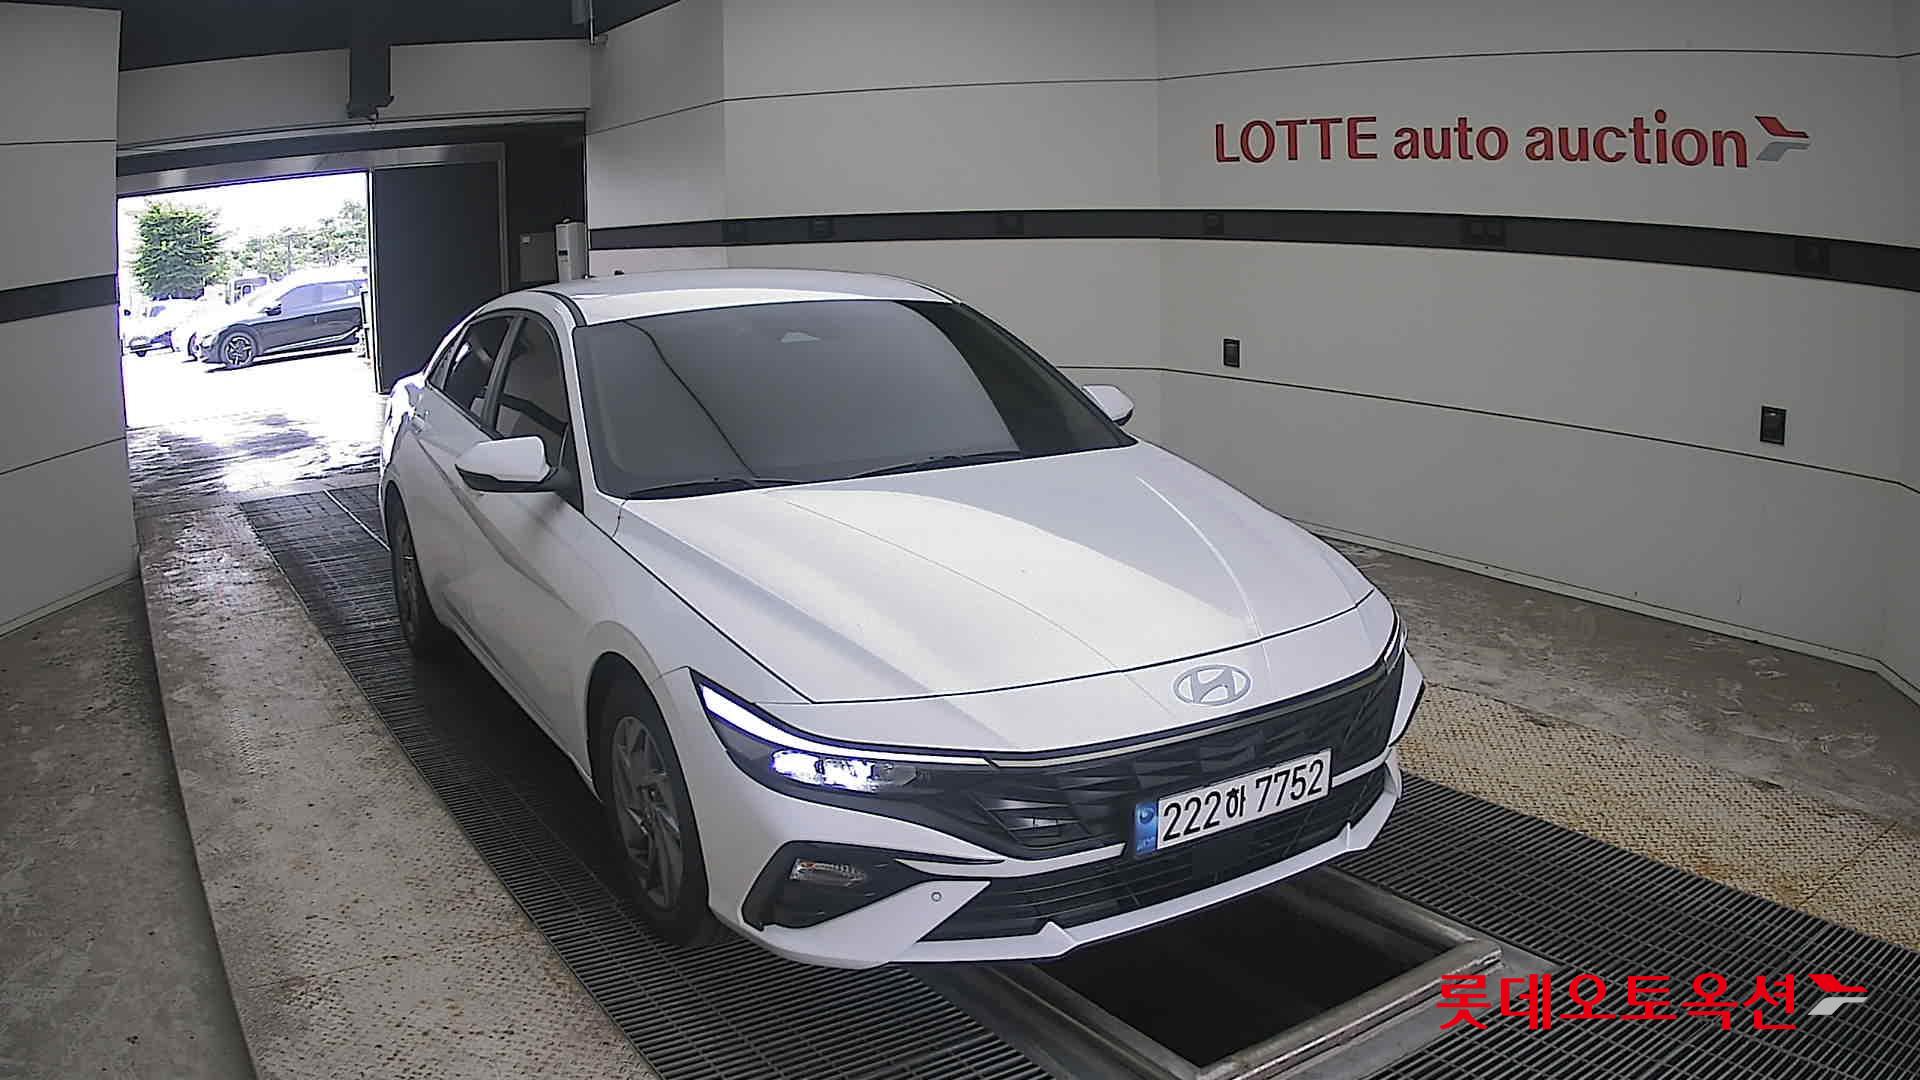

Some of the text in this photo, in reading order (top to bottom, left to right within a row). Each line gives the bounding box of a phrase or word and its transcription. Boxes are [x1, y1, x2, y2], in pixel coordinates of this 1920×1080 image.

[1215, 109, 1749, 169] LOTTE auto auction
[1163, 760, 1324, 841] 222하 7752
